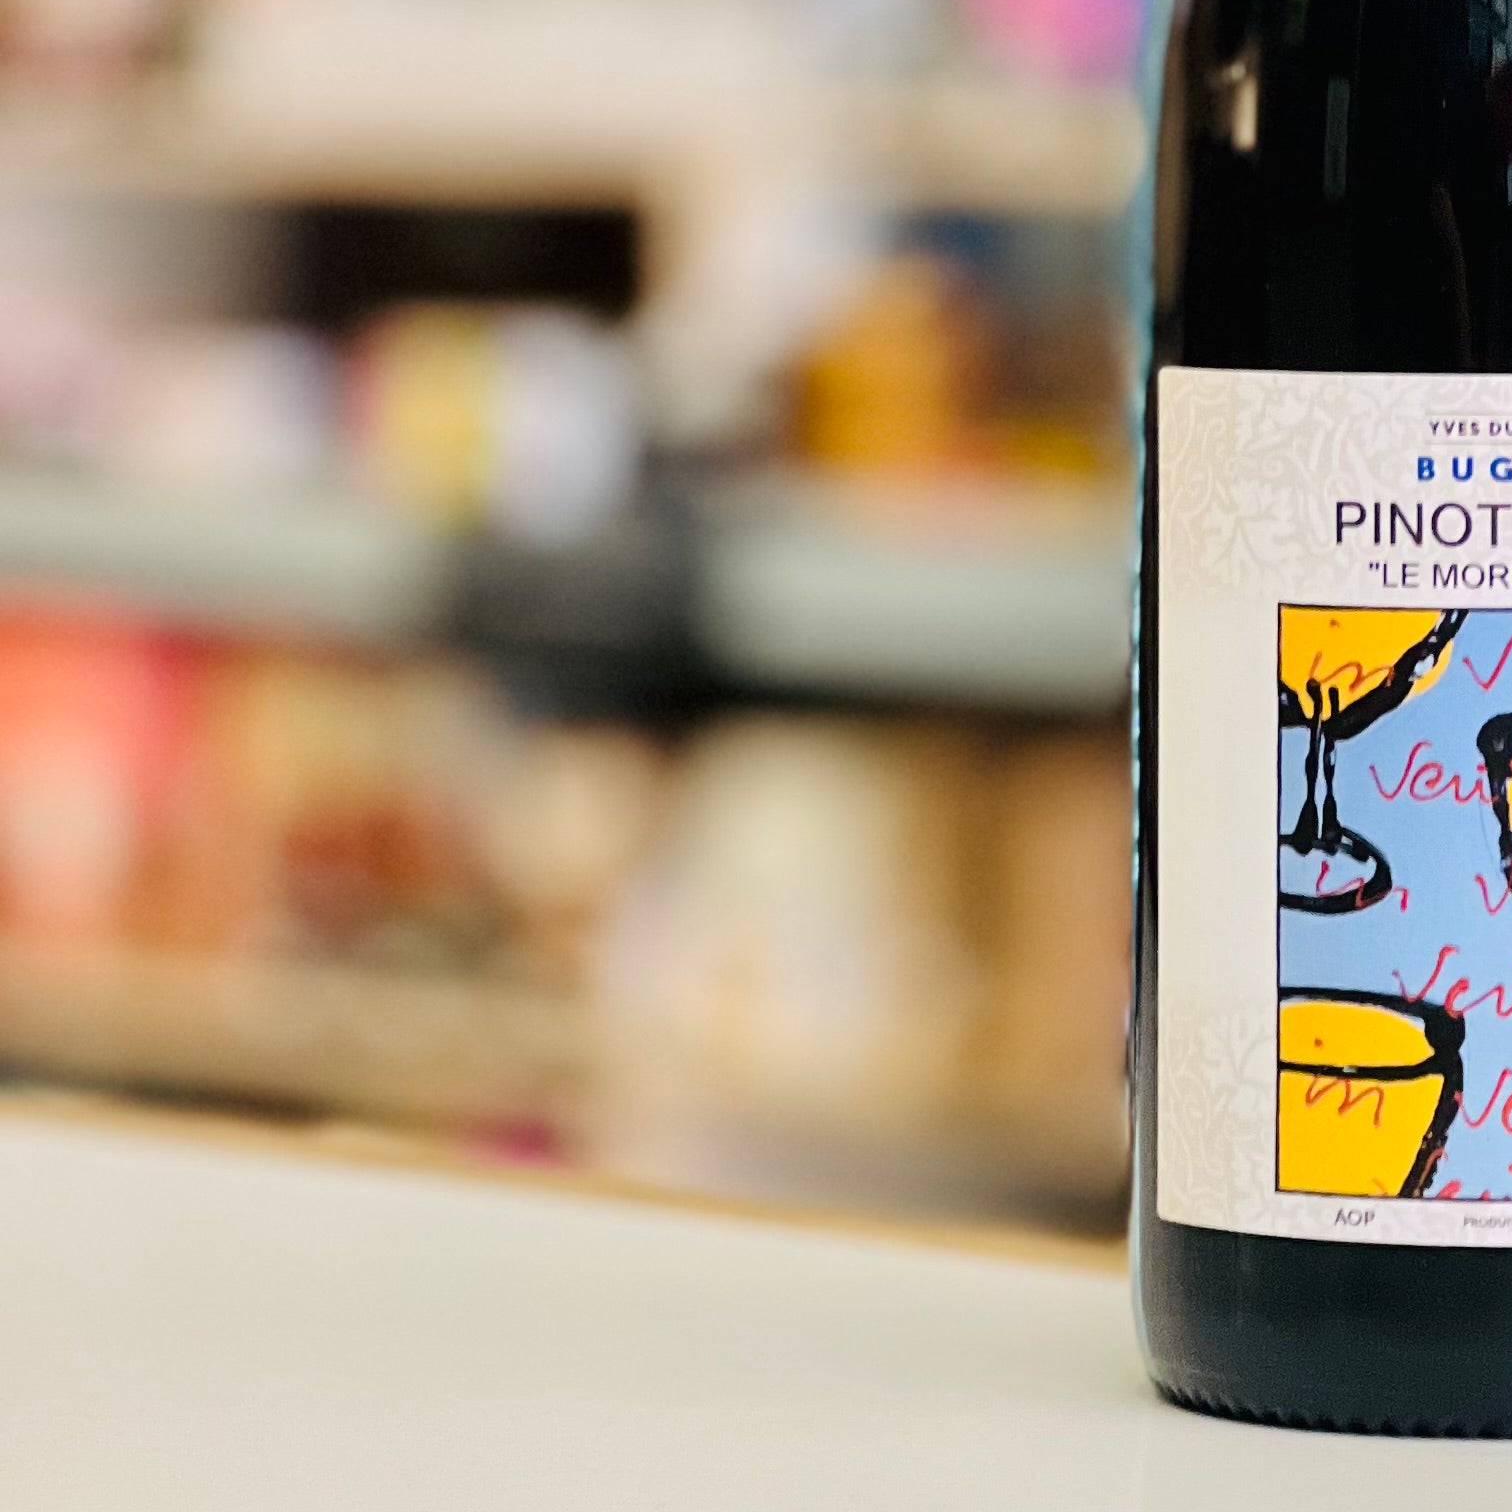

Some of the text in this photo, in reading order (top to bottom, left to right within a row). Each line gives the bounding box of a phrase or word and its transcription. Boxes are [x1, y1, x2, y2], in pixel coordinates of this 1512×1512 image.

[1429, 420, 1480, 436] YVES
[1335, 501, 1512, 548] PINOT
[1368, 562, 1421, 589] "LE
[1334, 1208, 1376, 1226] AOP
